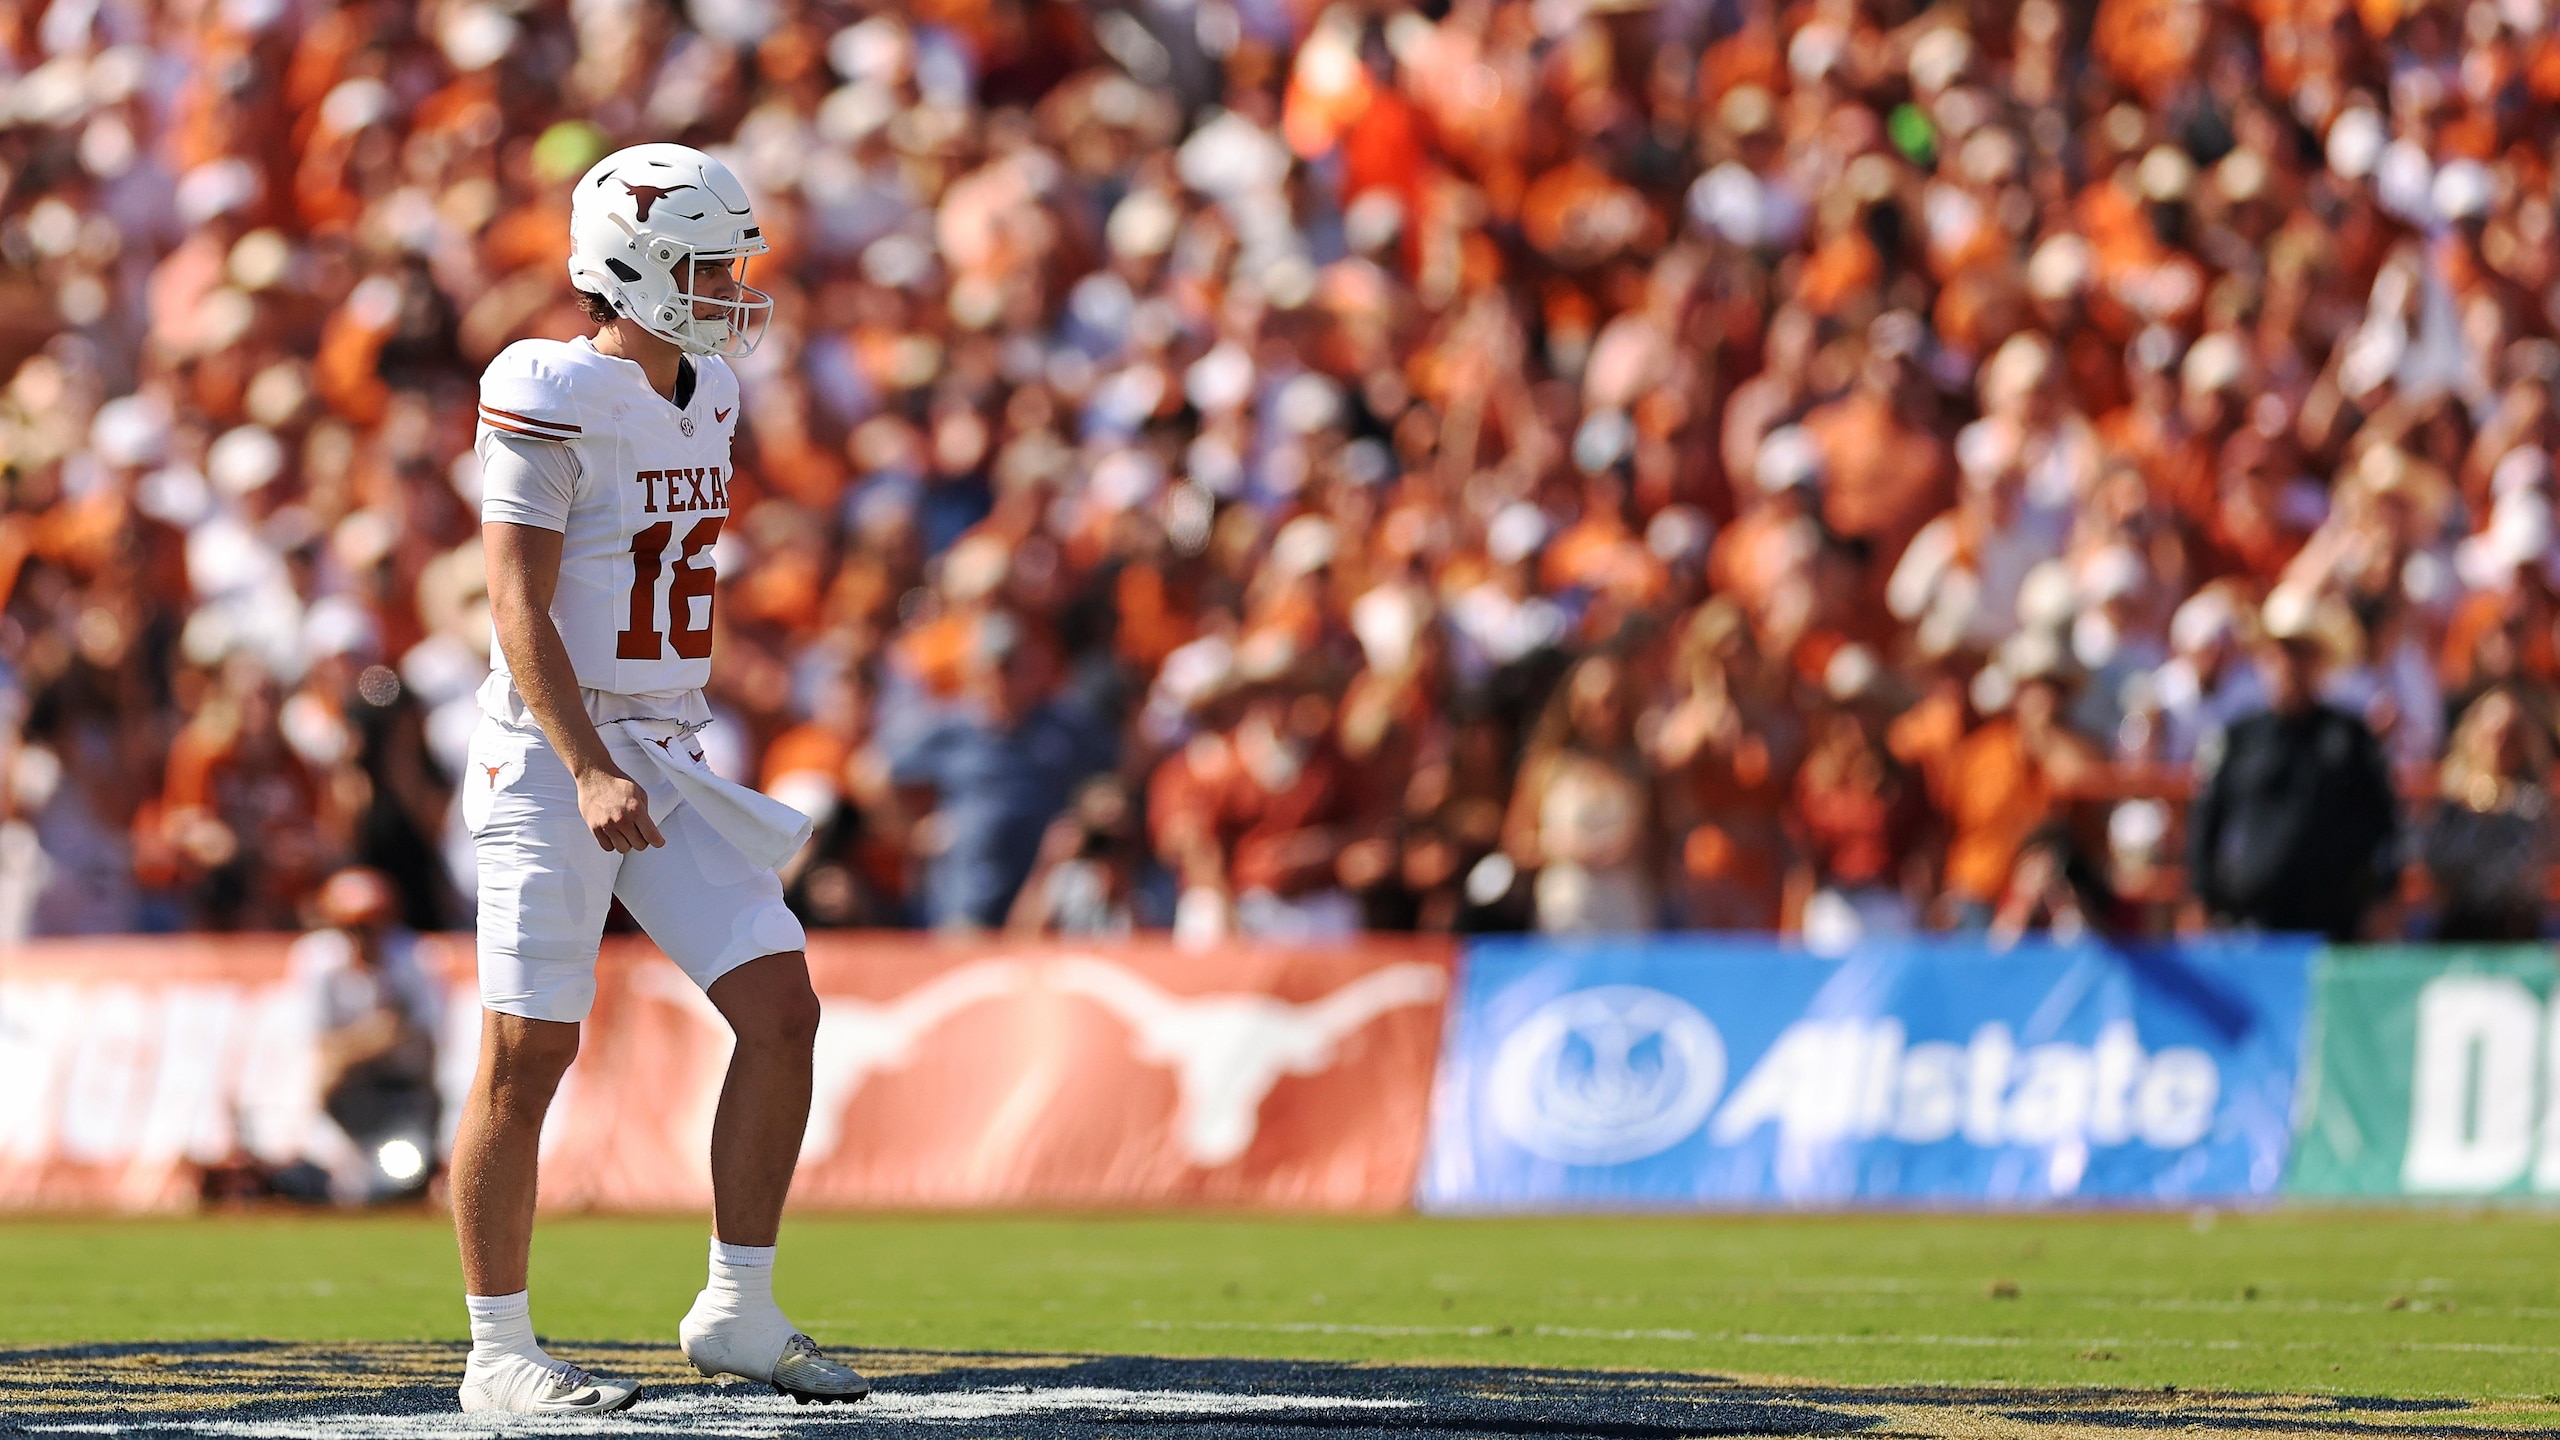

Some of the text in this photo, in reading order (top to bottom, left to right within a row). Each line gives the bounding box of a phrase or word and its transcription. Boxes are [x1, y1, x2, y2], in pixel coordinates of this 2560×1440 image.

[636, 467, 729, 513] TEXA
[616, 517, 725, 660] 16
[1711, 1014, 2220, 1148] Allstate
[2399, 972, 2560, 1190] D
